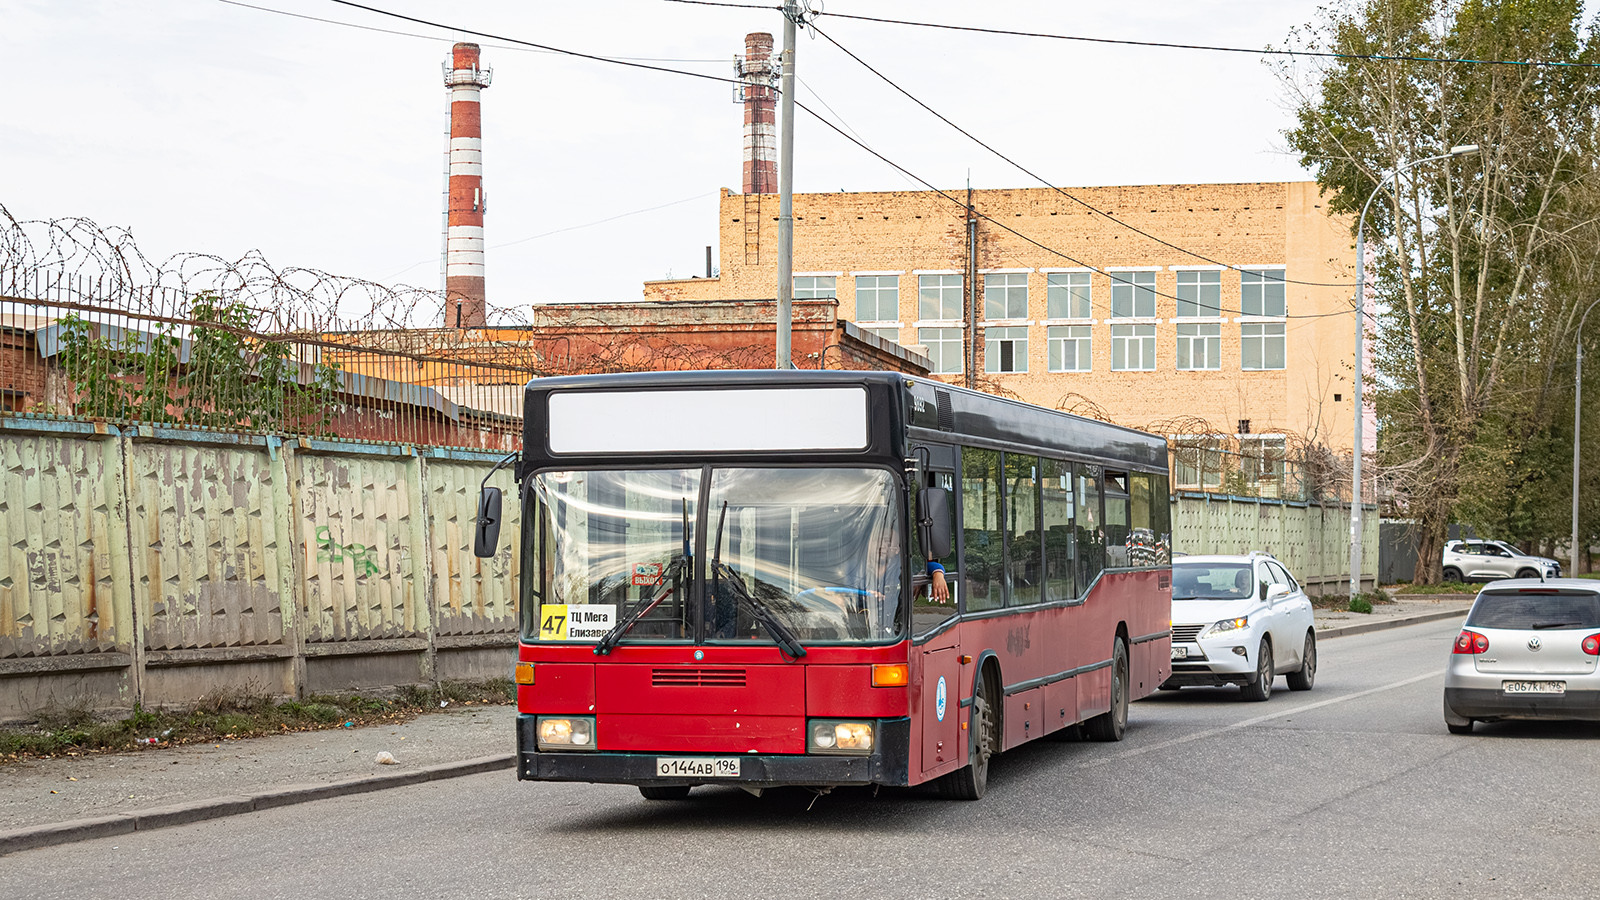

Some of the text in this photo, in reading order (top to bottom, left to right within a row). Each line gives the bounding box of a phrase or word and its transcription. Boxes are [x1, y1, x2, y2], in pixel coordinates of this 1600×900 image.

[570, 611, 608, 624] ТЦ Мега
[542, 615, 566, 635] 47
[715, 760, 736, 771] 196
